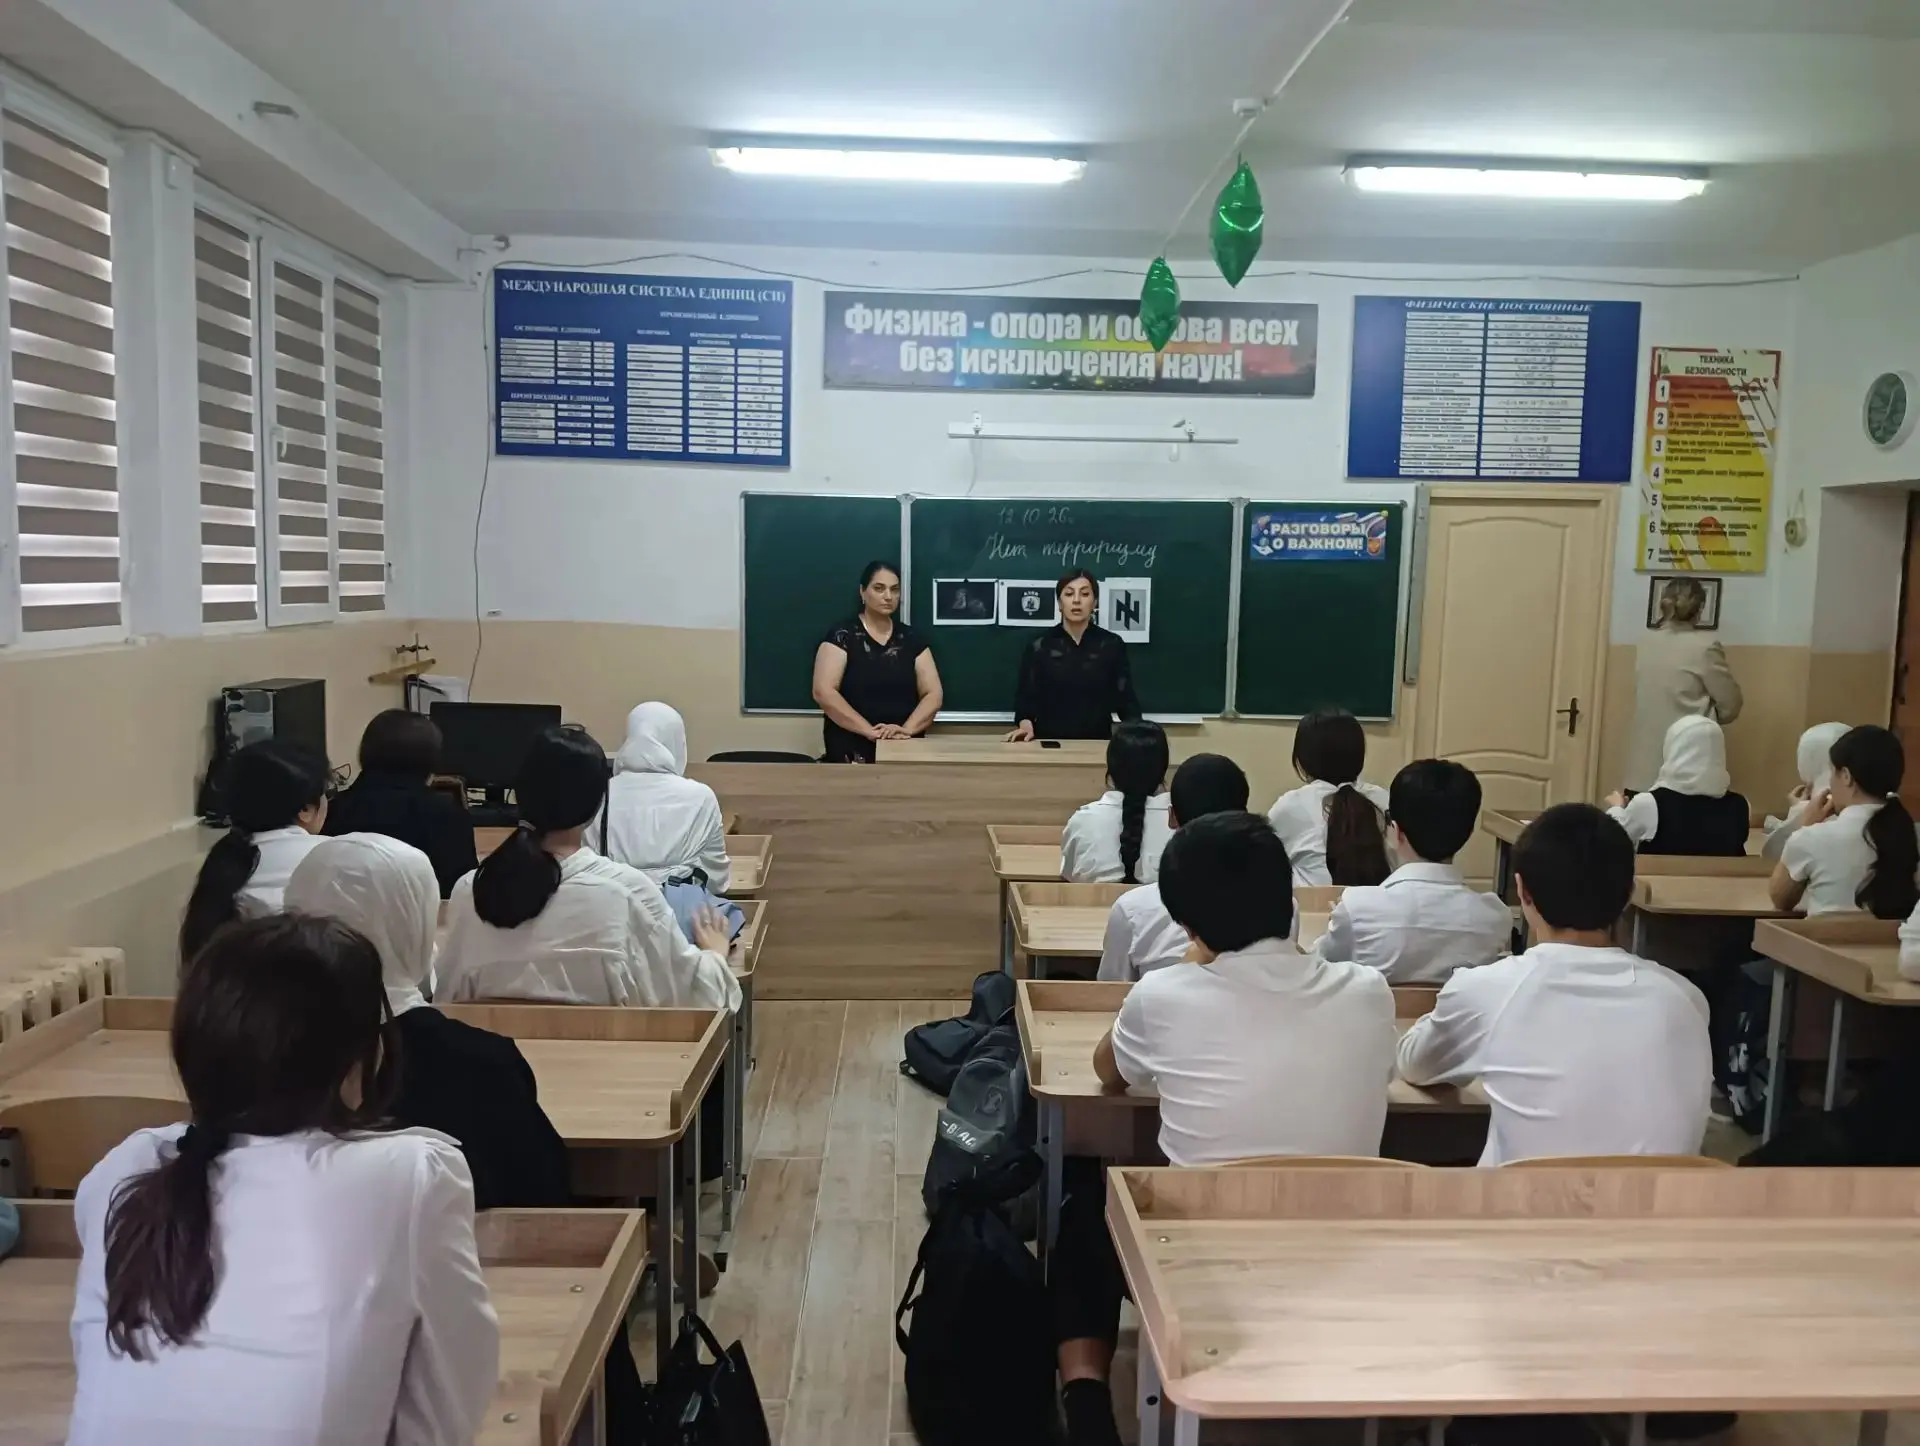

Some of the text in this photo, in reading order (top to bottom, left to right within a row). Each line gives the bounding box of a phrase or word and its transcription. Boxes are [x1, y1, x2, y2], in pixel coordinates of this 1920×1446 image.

[502, 279, 787, 303] МЕЖДУНАРОДНАЯ СИСТЕМА ЕДИНИЦ (СИ)
[1404, 299, 1496, 310] ФИЗИЧЕСКИЕ
[844, 303, 1300, 346] Физика - опора и осова всех
[900, 341, 1243, 383] без исключения наук!
[1699, 355, 1735, 364] ТЕХНИКА
[1684, 366, 1747, 377] БЕЗОПАСНОСТИ
[1660, 385, 1666, 397] 1
[1657, 412, 1664, 425] 2
[1655, 440, 1662, 452] 3
[1653, 467, 1660, 478] 4
[1651, 494, 1658, 506] 5
[1270, 523, 1367, 536] РАЗГОВОРЫ
[1649, 521, 1656, 533] 6
[1272, 537, 1364, 550] О ВАЖНОМ!
[985, 532, 1159, 568] Нет терроризму
[1647, 548, 1655, 560] 7
